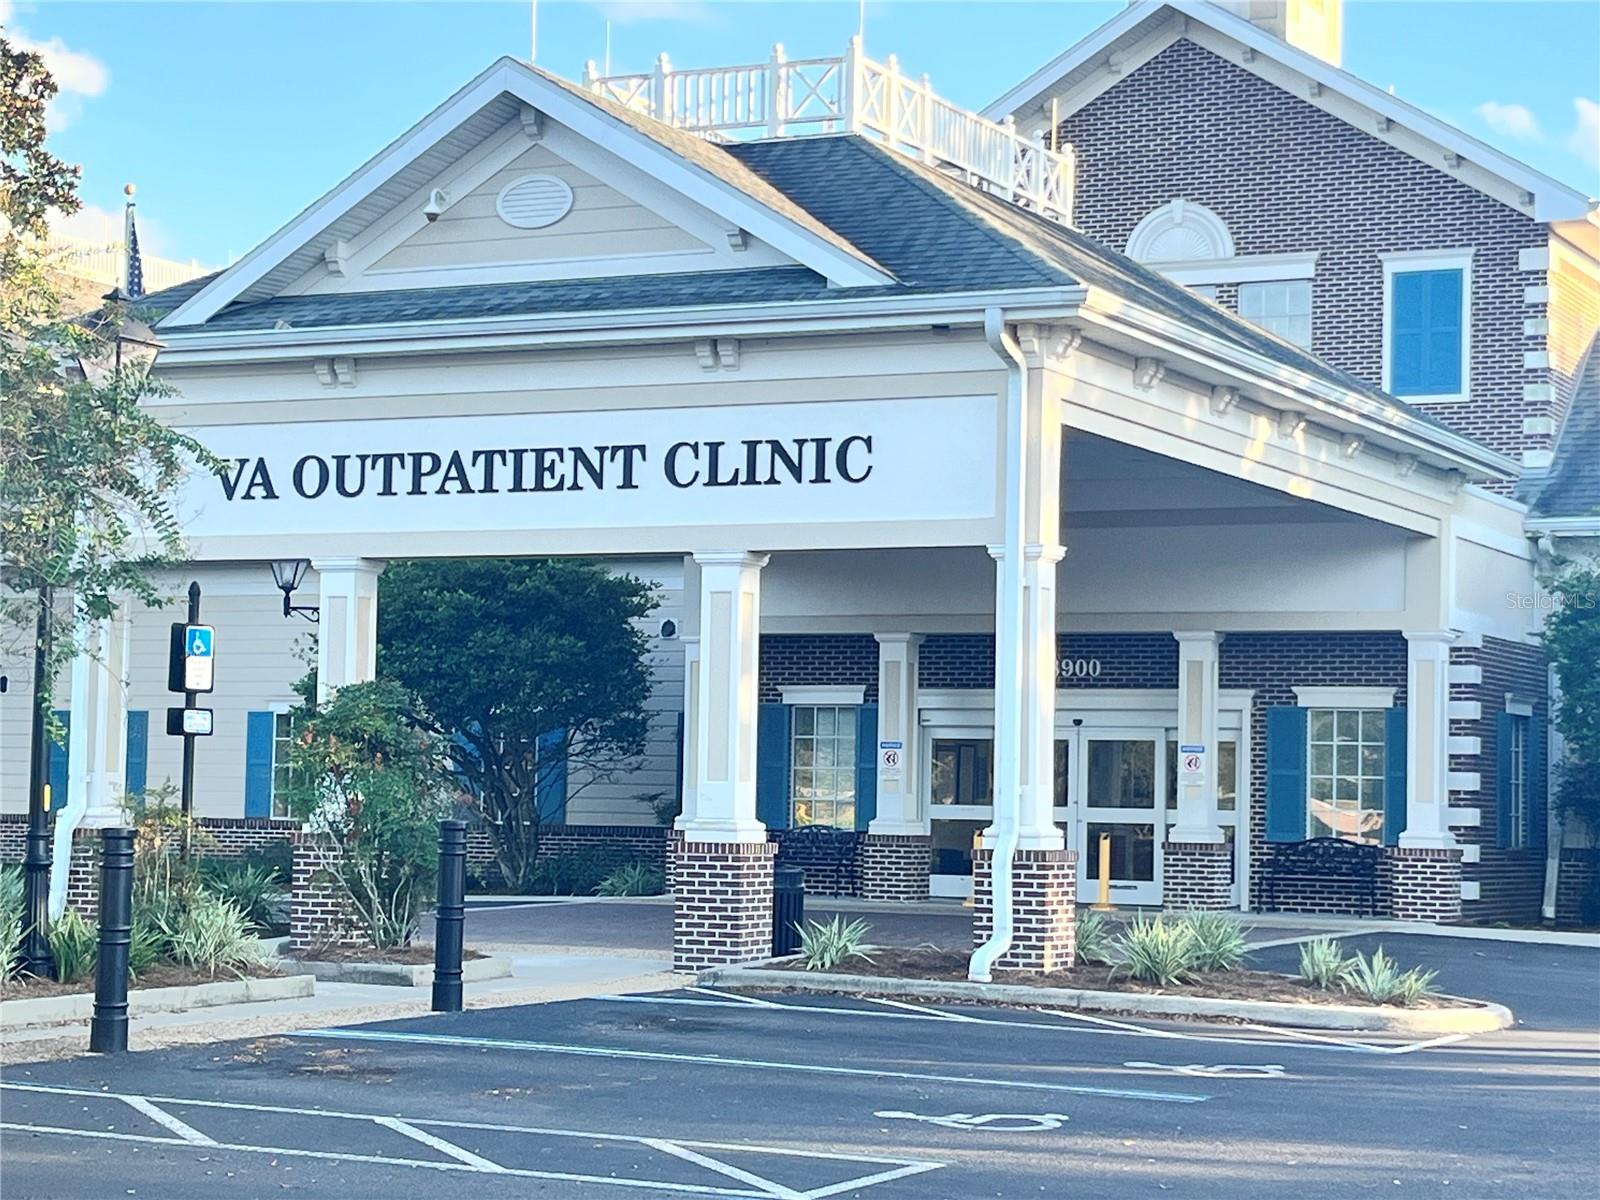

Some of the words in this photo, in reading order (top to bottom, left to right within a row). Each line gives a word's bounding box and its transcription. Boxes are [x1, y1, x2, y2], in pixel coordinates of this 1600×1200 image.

[218, 457, 280, 501] VA
[292, 445, 647, 499] OUTPATIENT
[664, 436, 873, 488] CLINIC
[1056, 659, 1101, 677] 900
